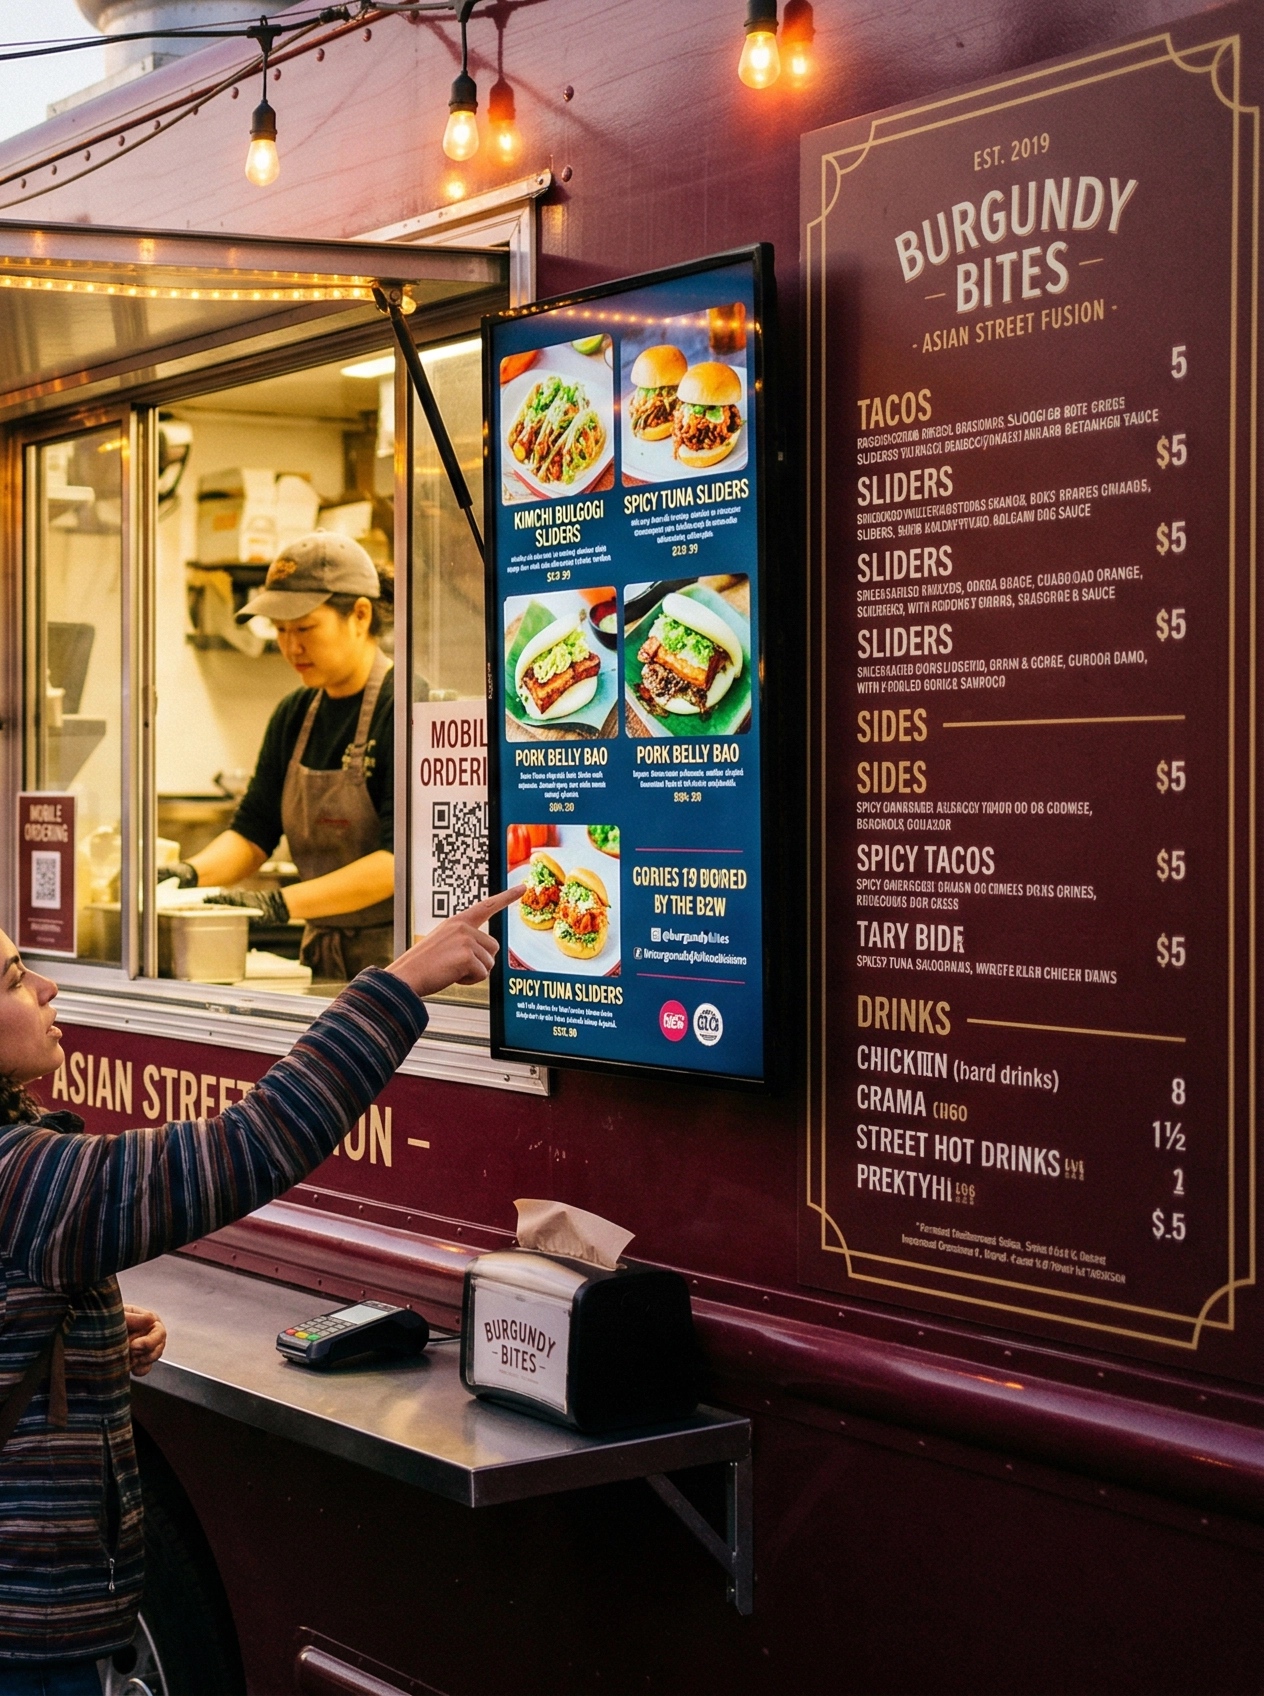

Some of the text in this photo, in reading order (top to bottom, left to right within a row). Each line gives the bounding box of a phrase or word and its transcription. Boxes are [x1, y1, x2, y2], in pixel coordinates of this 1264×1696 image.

[974, 132, 1050, 172] EST. 2019
[894, 175, 1138, 285] BURGUNDY
[956, 240, 1069, 314] BITES
[922, 298, 1104, 354] ASIAN STREET FUSION
[1170, 345, 1188, 379] 5
[857, 388, 932, 430] TACOS
[1156, 433, 1188, 470] $5
[623, 478, 750, 515] SPICY TUNA SLIDERS
[857, 465, 953, 507] SLIDERS
[514, 506, 553, 530] KIMCHI
[555, 499, 604, 526] BULGOGI
[535, 523, 581, 548] SLIDERS
[1156, 522, 1188, 556] $5
[857, 545, 953, 583] SLIDERS
[1082, 586, 1116, 601] SAUCE
[857, 623, 953, 659] SLIDERS
[1156, 609, 1188, 642] $5
[431, 718, 488, 748] MOBIL
[856, 707, 928, 743] SIDES
[420, 756, 488, 787] ORDERI
[515, 746, 608, 767] PORK BELLY BAO
[637, 743, 740, 765] PORK BELLY BAO
[856, 759, 928, 794] SIDES
[1156, 759, 1187, 795] $5
[856, 844, 995, 876] SPICY TACOS
[1156, 848, 1187, 883] $5
[654, 894, 726, 917] BY THE B2W
[856, 920, 909, 951] TARY
[1156, 932, 1187, 968] $5
[508, 977, 624, 1006] SPICY TUNA SLIDERS
[856, 994, 951, 1037] DRINKS
[51, 1051, 133, 1115] ASIAN
[1000, 1062, 1059, 1094] drinks)
[1170, 1078, 1186, 1106] 8
[856, 1083, 926, 1117] CRAMA
[856, 1124, 929, 1158] STREET
[934, 1134, 975, 1164] HOT
[981, 1140, 1061, 1178] DRINKS
[484, 1319, 556, 1358] BURGUNDY
[501, 1343, 537, 1374] BITES
